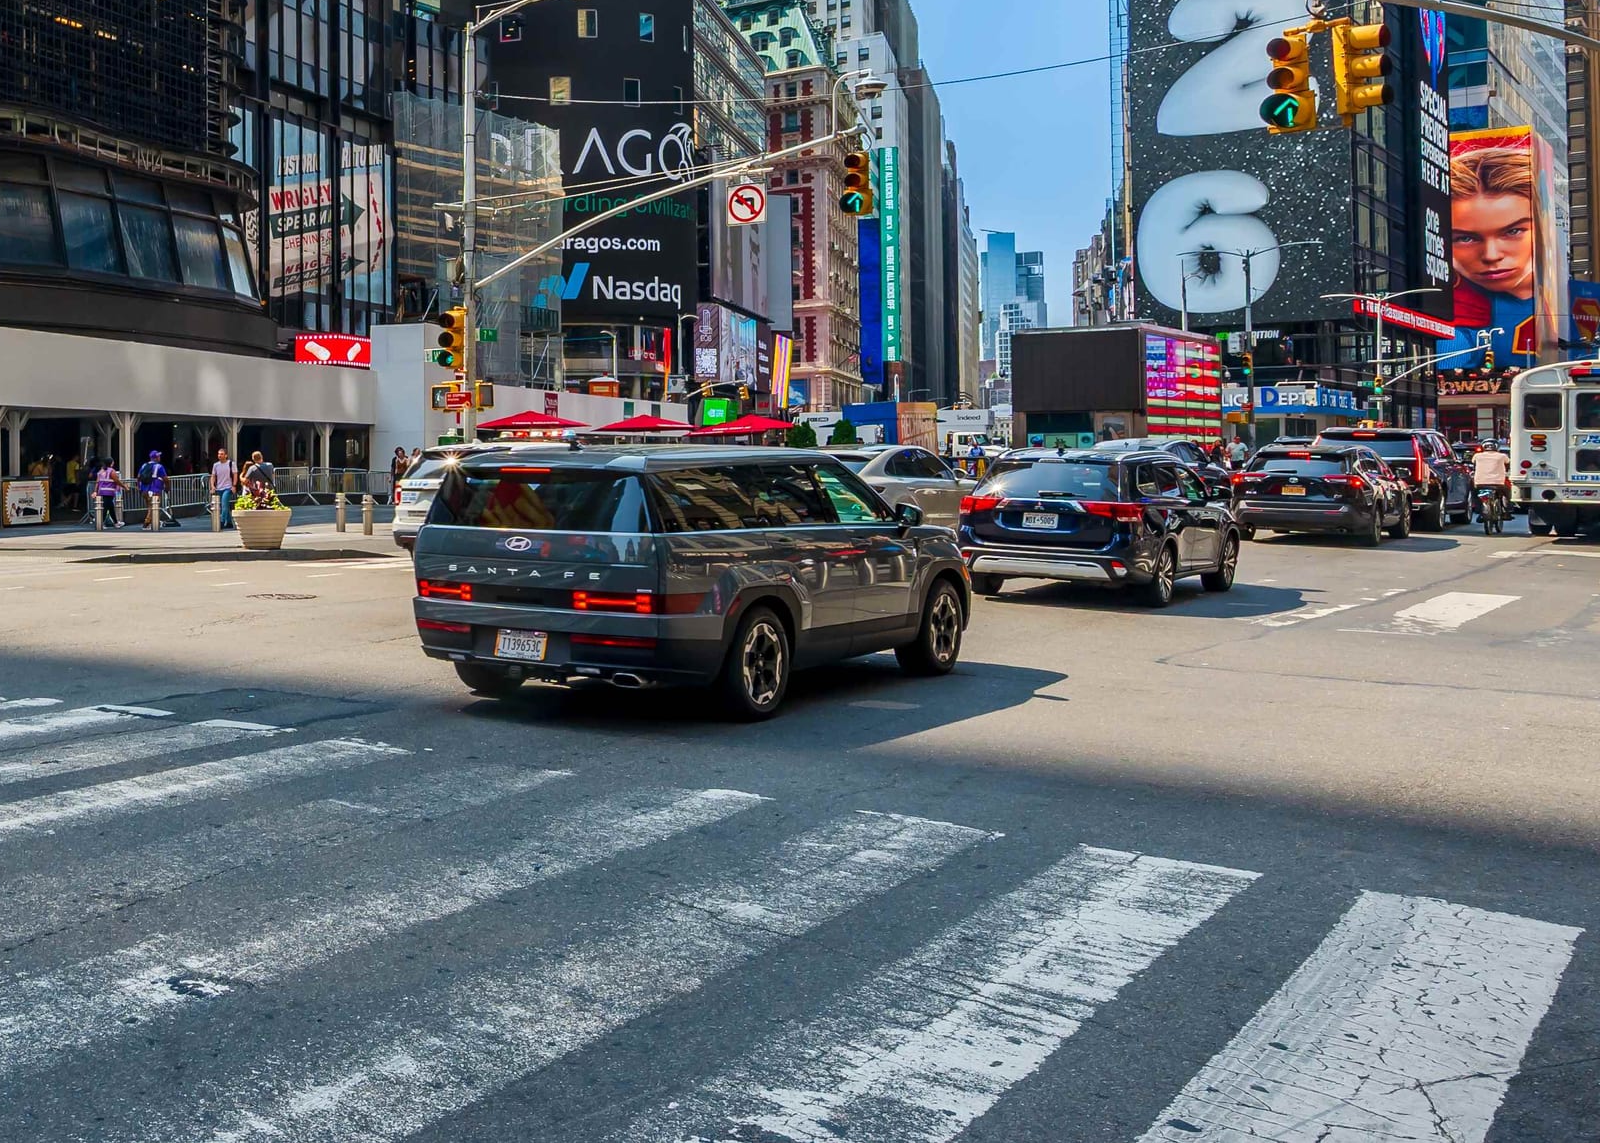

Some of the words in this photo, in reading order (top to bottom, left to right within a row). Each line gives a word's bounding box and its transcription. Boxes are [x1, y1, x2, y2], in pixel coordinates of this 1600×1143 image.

[1420, 80, 1448, 126] SPECIAL
[1421, 110, 1448, 152] PREVIEW
[1421, 138, 1449, 171] EXPERIENCES
[1421, 160, 1440, 189] HERE
[1440, 177, 1450, 195] AT
[277, 205, 345, 233] SPEARMIT
[1426, 207, 1440, 232] one
[1426, 227, 1445, 258] times
[1426, 253, 1450, 286] square
[593, 275, 681, 309] Nasdaq
[1251, 330, 1280, 338] DITION
[449, 564, 542, 578] SANTA
[563, 570, 601, 581] FE
[502, 637, 542, 653] T139653C
